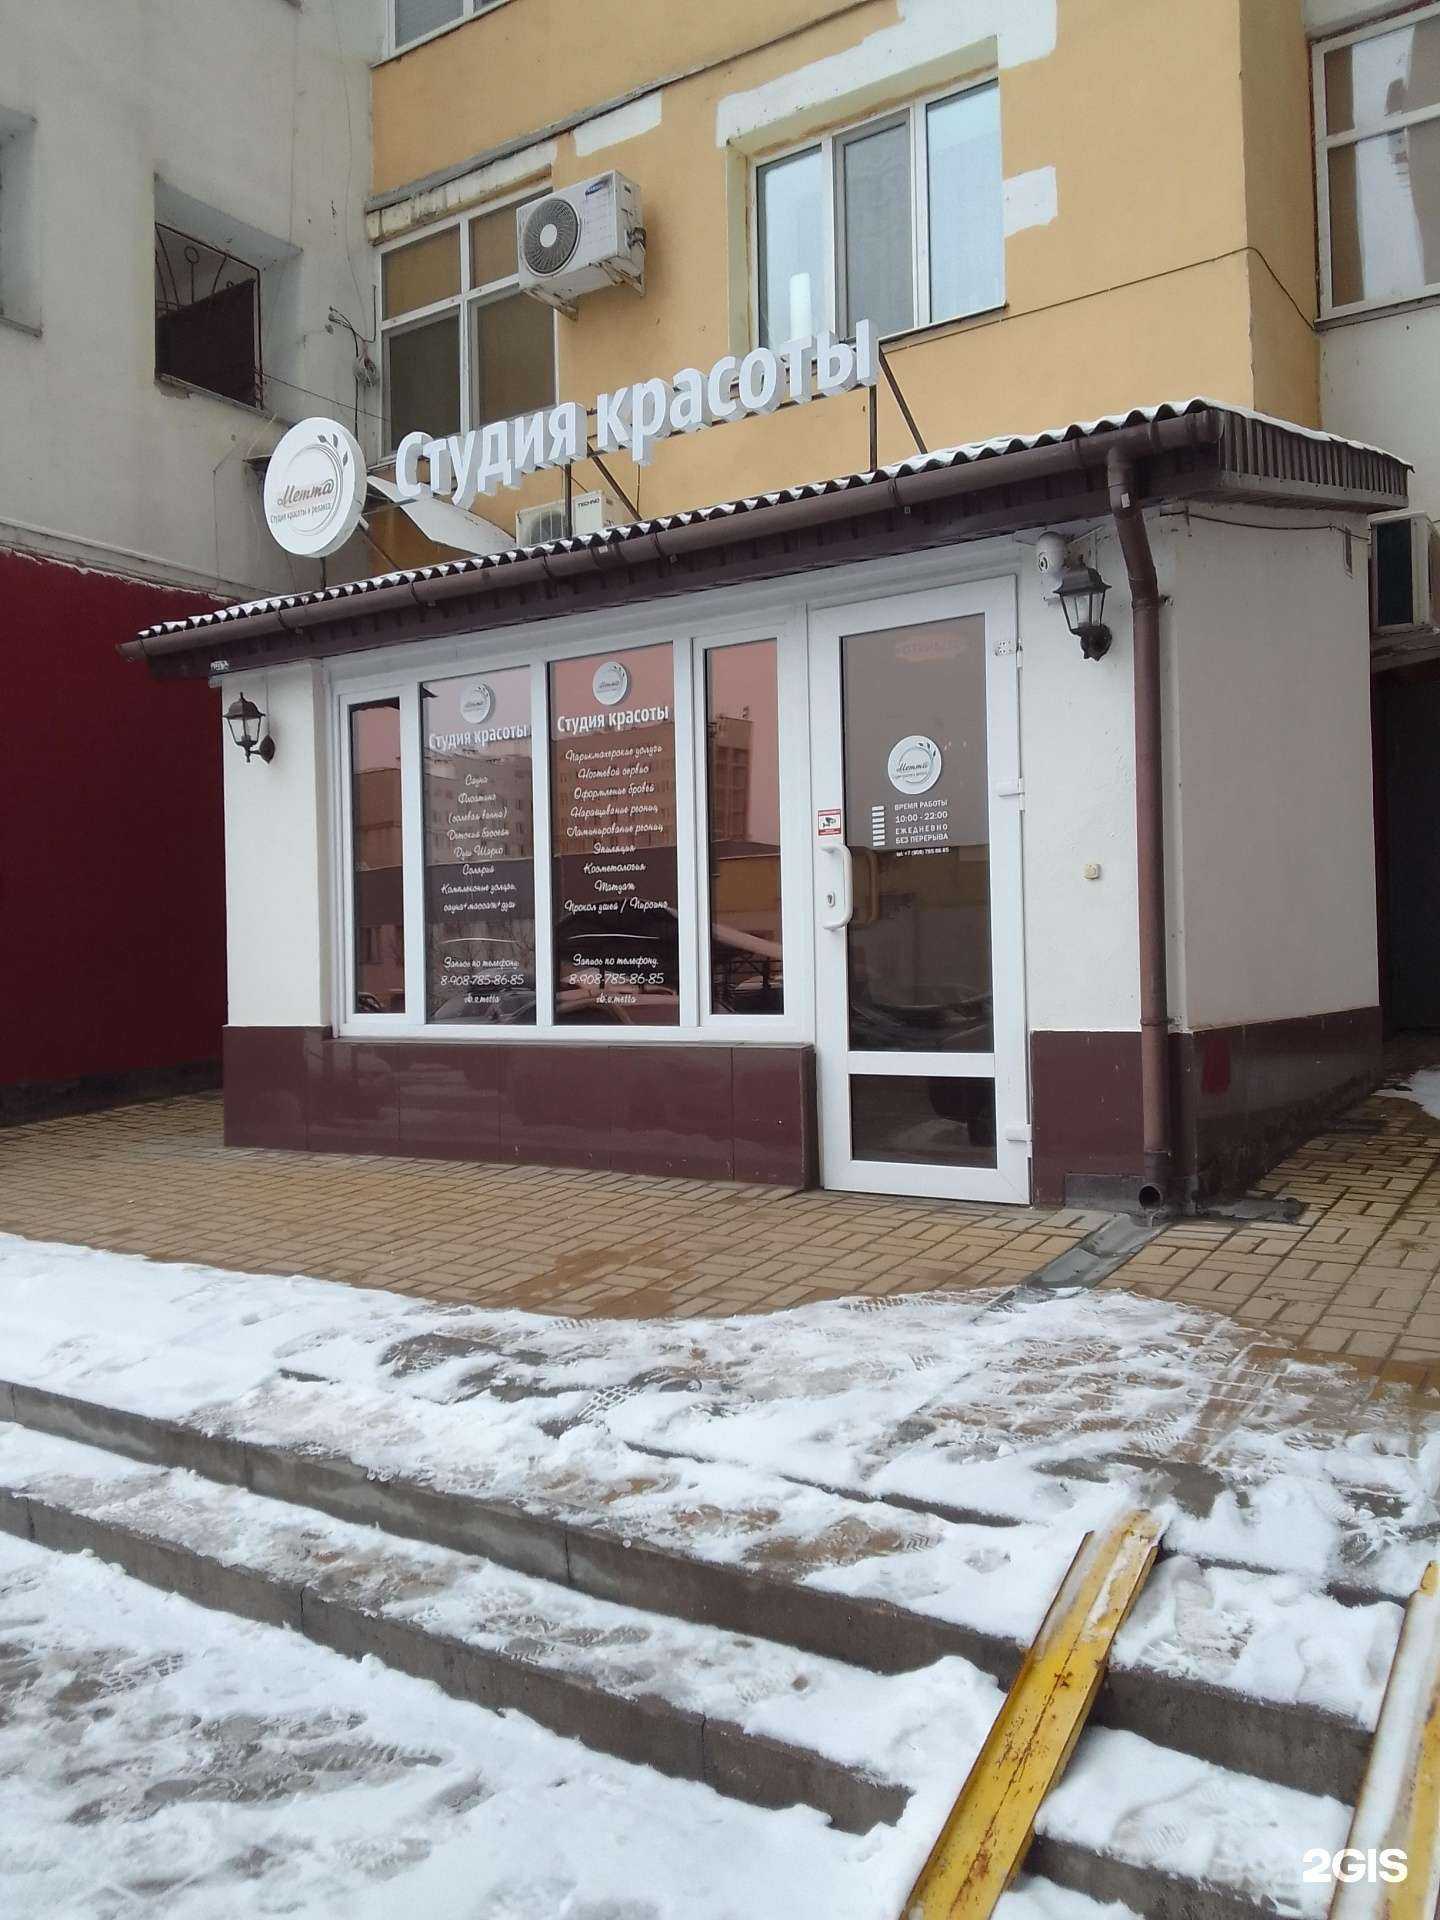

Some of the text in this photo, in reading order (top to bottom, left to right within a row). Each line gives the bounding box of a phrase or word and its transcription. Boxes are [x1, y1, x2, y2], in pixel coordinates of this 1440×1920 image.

[395, 320, 873, 506] Студия красоты
[557, 706, 669, 735] Студия красоты
[429, 725, 527, 751] Студия красоты
[565, 744, 663, 764] Парикмахерские услуги
[578, 762, 649, 779] Ногтевой сервис
[465, 774, 488, 787] Сауна
[574, 780, 655, 802] Оформление бровей
[571, 803, 658, 820] Наращивание ресниц
[894, 799, 948, 811] ВРЕМЯ РАБОТЫ
[895, 813, 918, 824] 10:00
[924, 811, 948, 821] 22:00
[567, 822, 664, 838] Ламинирование ресниц
[895, 824, 948, 835] ЕЖЕДНЕВНО
[895, 834, 948, 844] БЕЗ ПЕРЕРЫВА
[454, 844, 503, 860] Душ Шарко
[592, 842, 636, 855] Эпиляция
[463, 864, 495, 876] Солярий
[583, 862, 646, 875] Косметология
[594, 880, 635, 894] Татуаж
[564, 899, 597, 915] Прокол
[598, 902, 619, 915] ушей
[629, 896, 668, 913] Пирсинг
[444, 956, 471, 969] Запись
[573, 953, 603, 966] Запись
[604, 958, 615, 966] по
[440, 974, 525, 986] 8-908-785-86-85
[569, 972, 665, 985] 8-908-785-86-85
